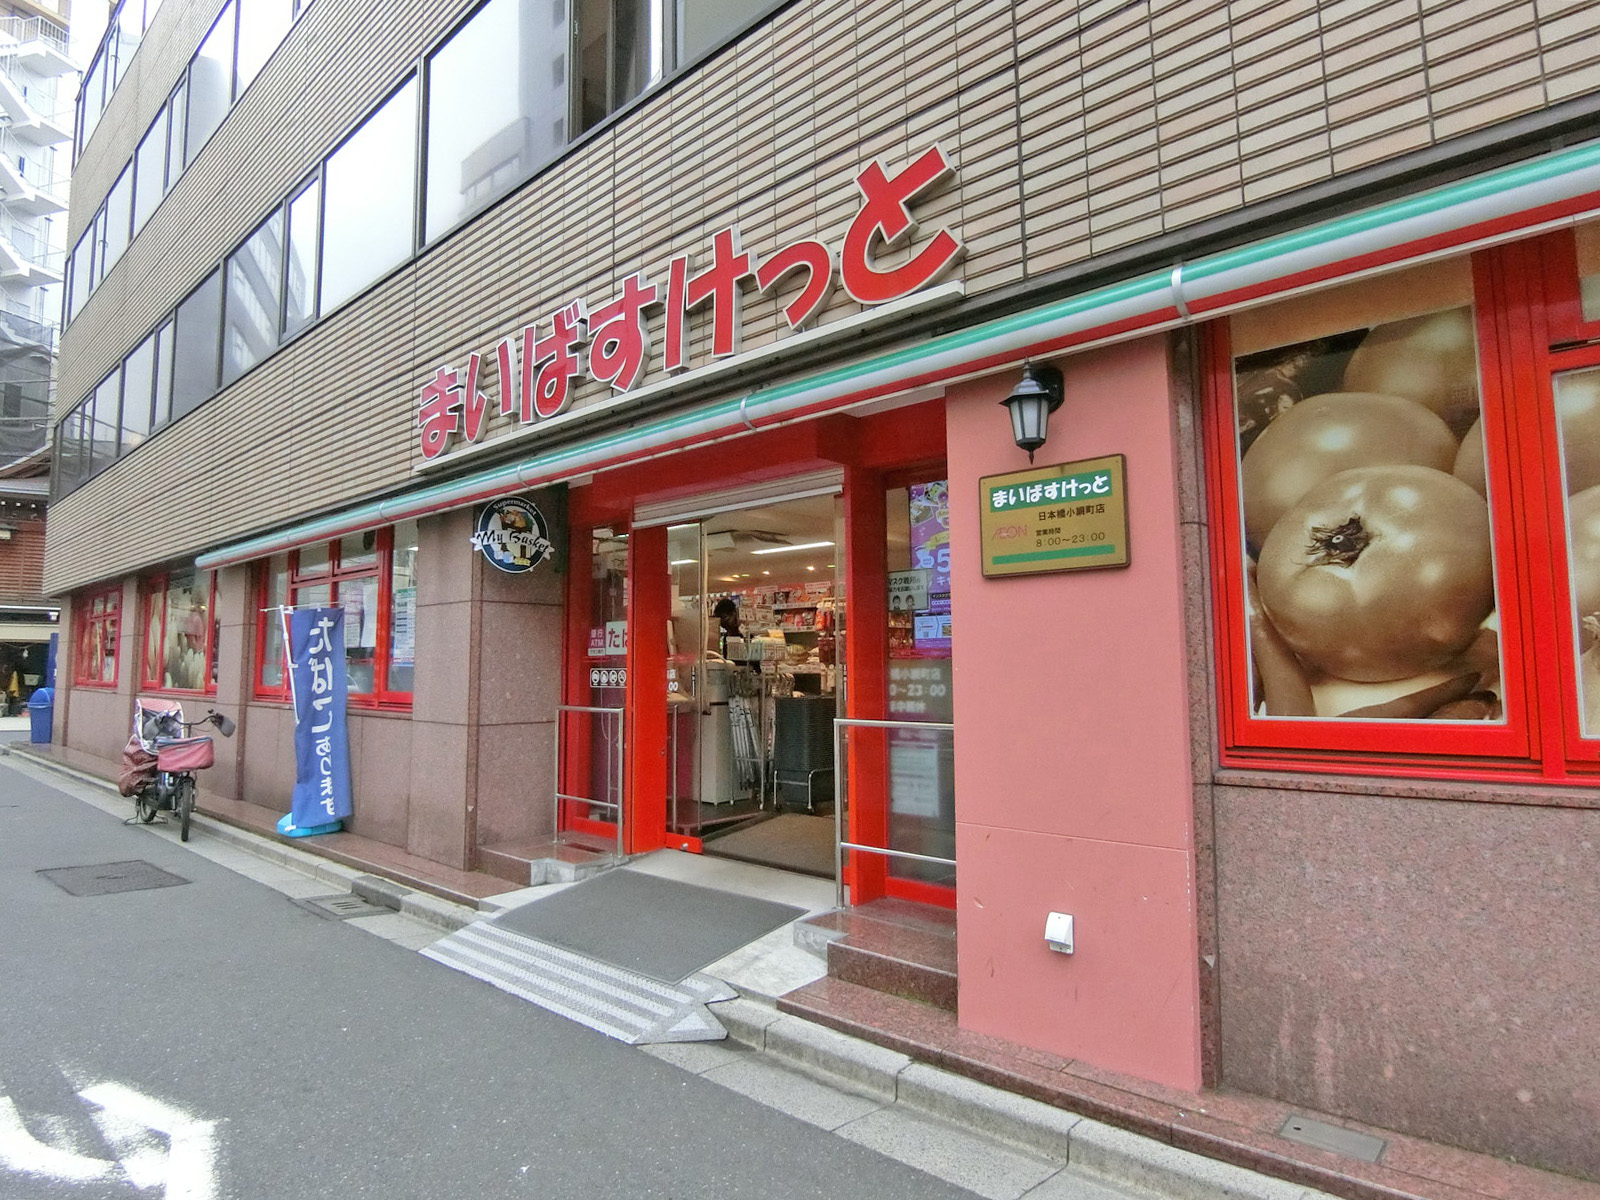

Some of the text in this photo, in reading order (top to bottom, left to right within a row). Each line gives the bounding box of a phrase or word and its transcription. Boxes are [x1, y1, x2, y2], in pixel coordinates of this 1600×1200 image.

[417, 142, 969, 461] まいばすけっと
[992, 475, 1110, 508] まいばすけっと
[493, 499, 538, 516] Supermarket
[476, 529, 549, 552] My Basket
[1035, 527, 1062, 536] 営業時間
